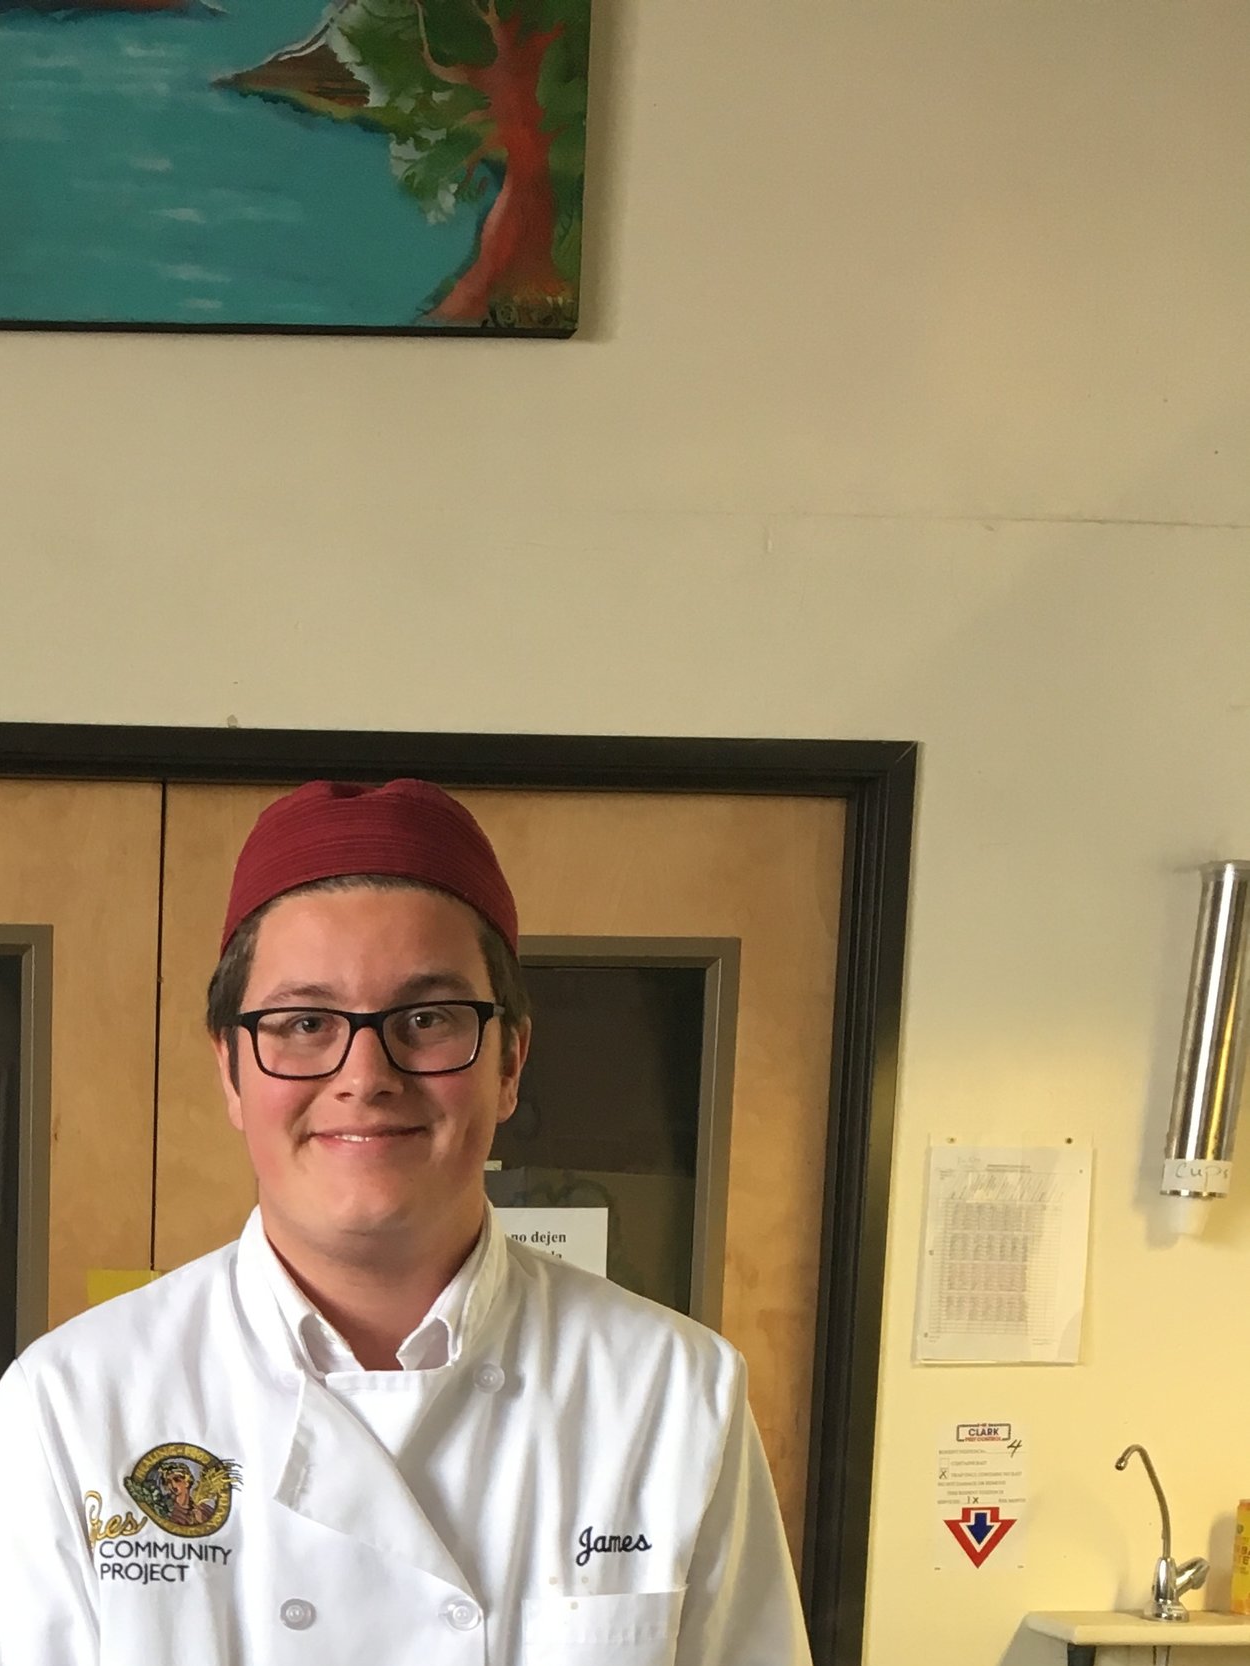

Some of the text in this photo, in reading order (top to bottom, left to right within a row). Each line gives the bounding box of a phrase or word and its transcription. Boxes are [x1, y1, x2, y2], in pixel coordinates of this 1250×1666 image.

[531, 1231, 567, 1246] dejen
[968, 1427, 999, 1437] CLARK
[1006, 1439, 1023, 1458] 4
[100, 1540, 232, 1565] COMMUNITY
[576, 1526, 652, 1566] James
[100, 1562, 190, 1585] PROJECT
